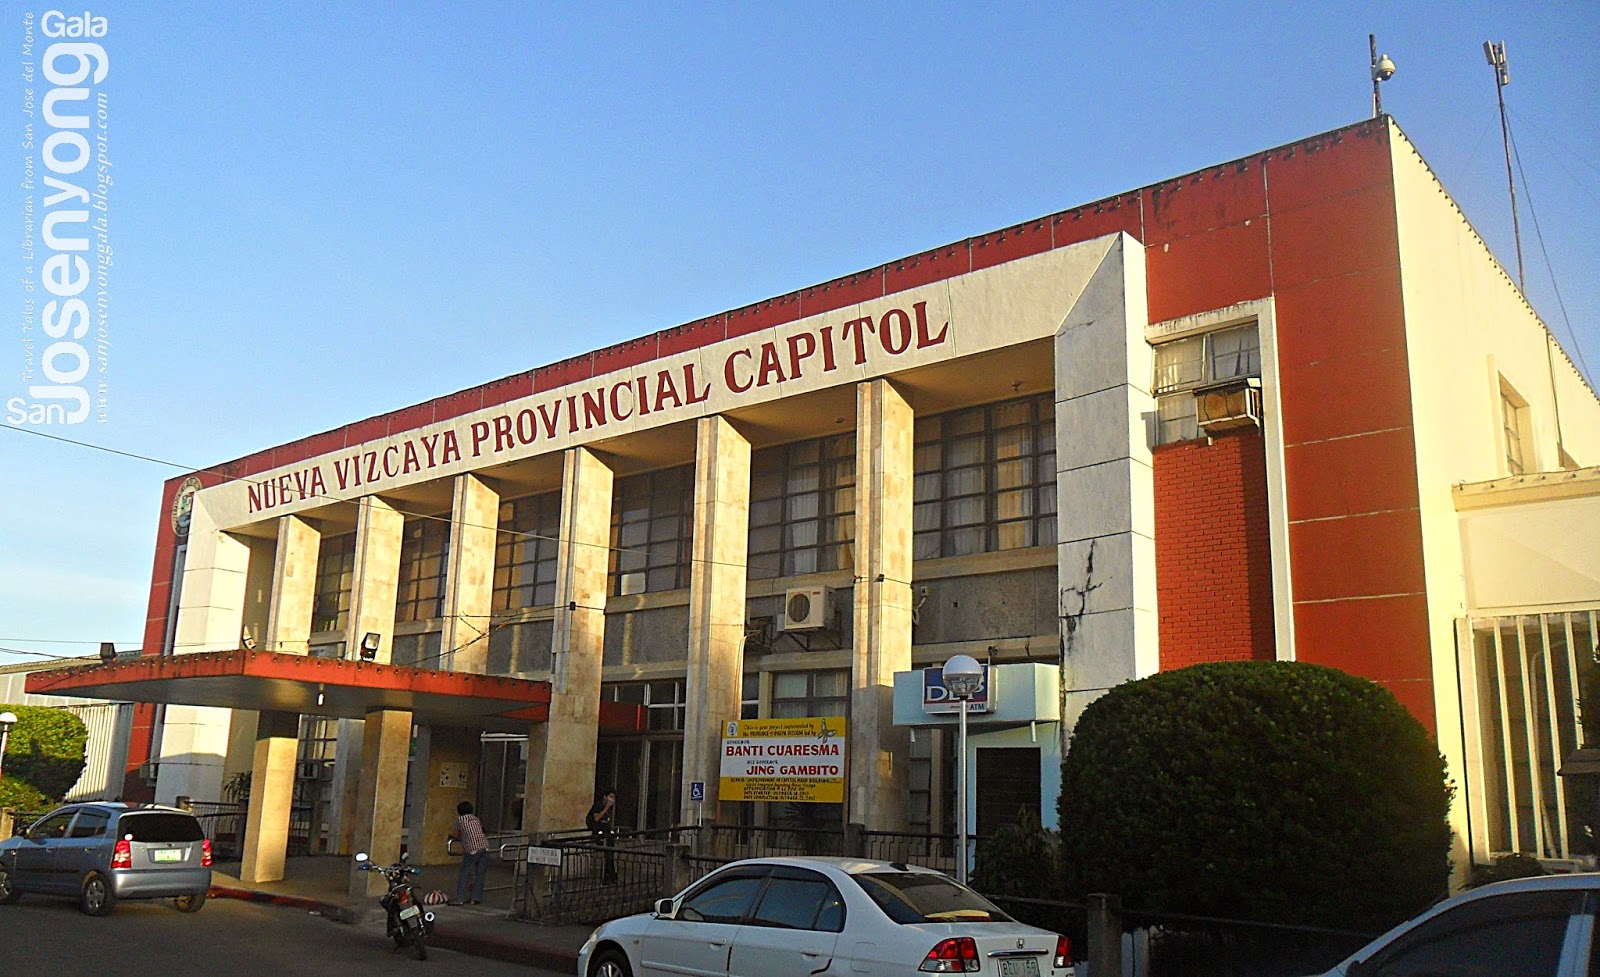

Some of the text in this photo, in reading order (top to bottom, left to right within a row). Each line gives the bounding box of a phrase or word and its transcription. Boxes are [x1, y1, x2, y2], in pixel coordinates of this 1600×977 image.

[248, 466, 327, 513] NUEVA
[334, 429, 461, 490] VIZCAYA
[471, 362, 711, 457] PROVINCIAL
[724, 301, 949, 394] CAPITOL
[969, 703, 985, 711] ATM
[726, 744, 839, 756] BANTI CUARESMA
[746, 765, 839, 775] JING GAMBITO
